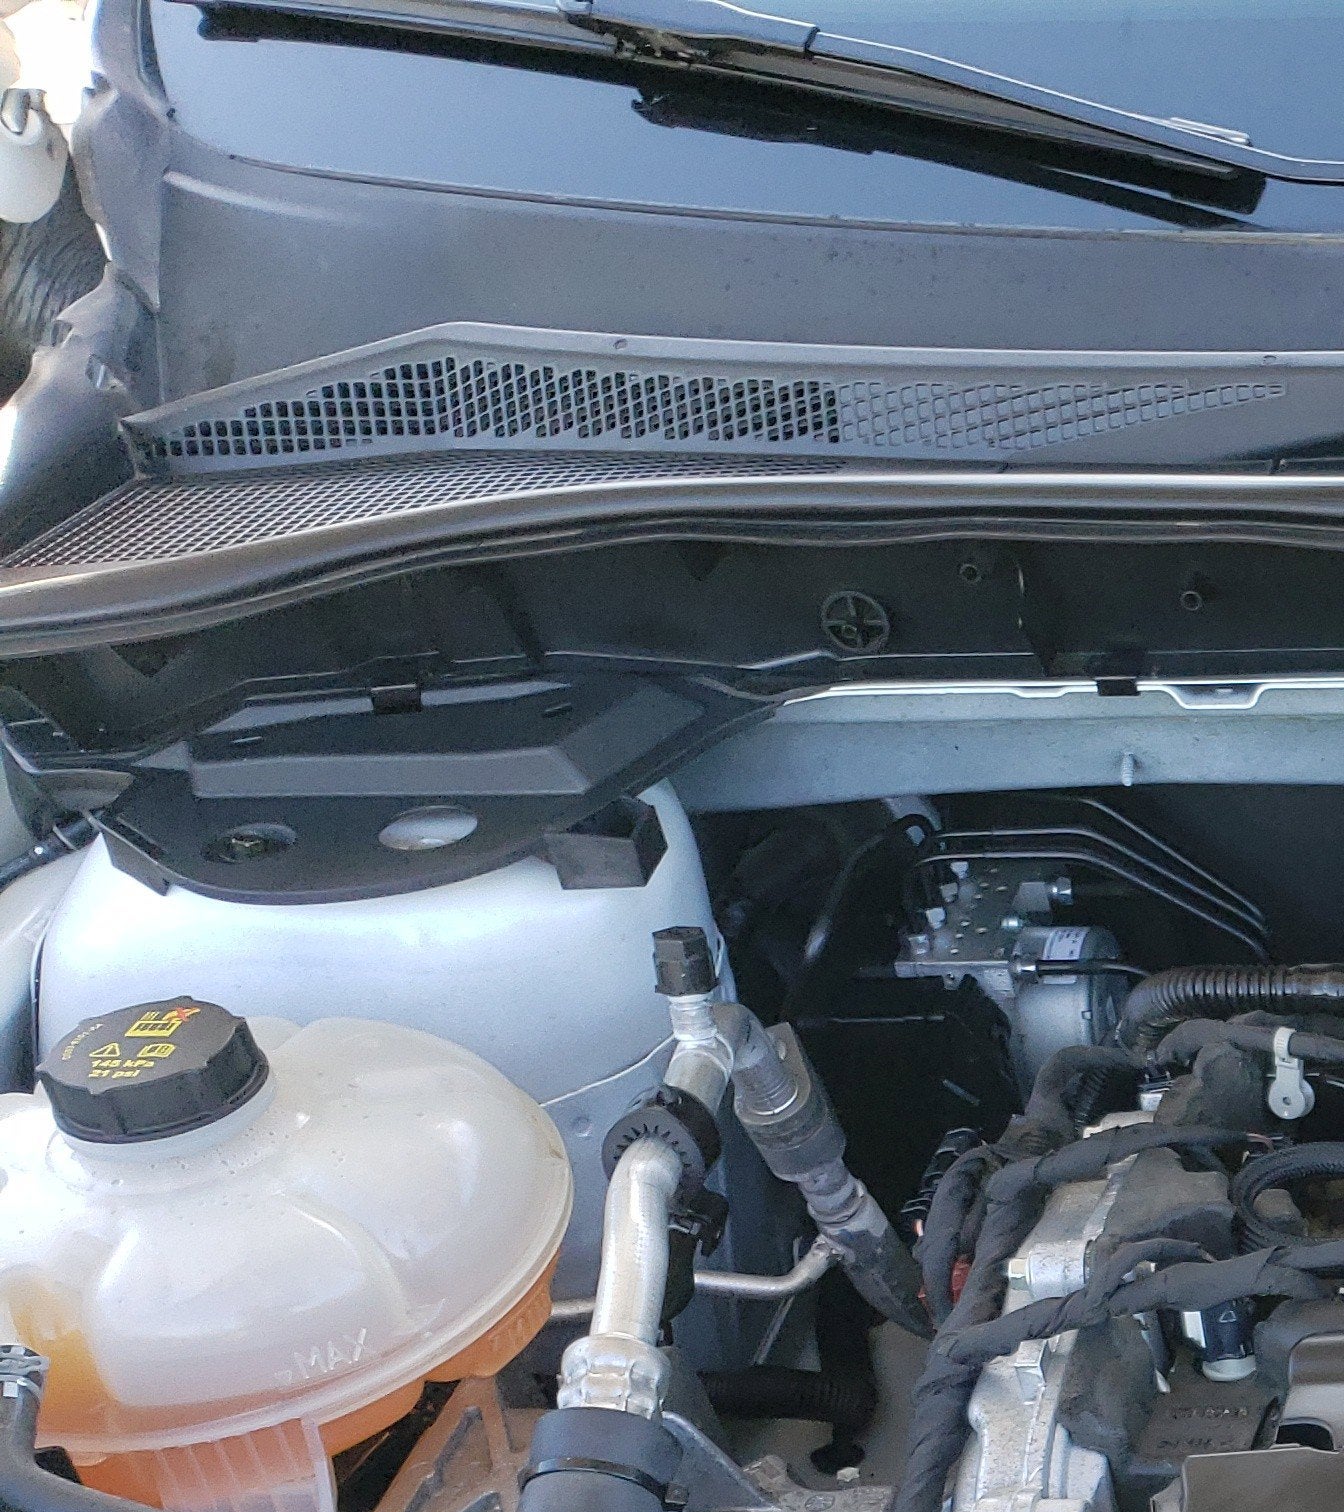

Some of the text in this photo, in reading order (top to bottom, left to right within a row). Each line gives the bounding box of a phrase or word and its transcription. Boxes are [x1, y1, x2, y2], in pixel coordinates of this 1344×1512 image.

[91, 1059, 155, 1068] 145 kPa
[111, 1069, 141, 1079] psi
[294, 1327, 368, 1379] MAX
